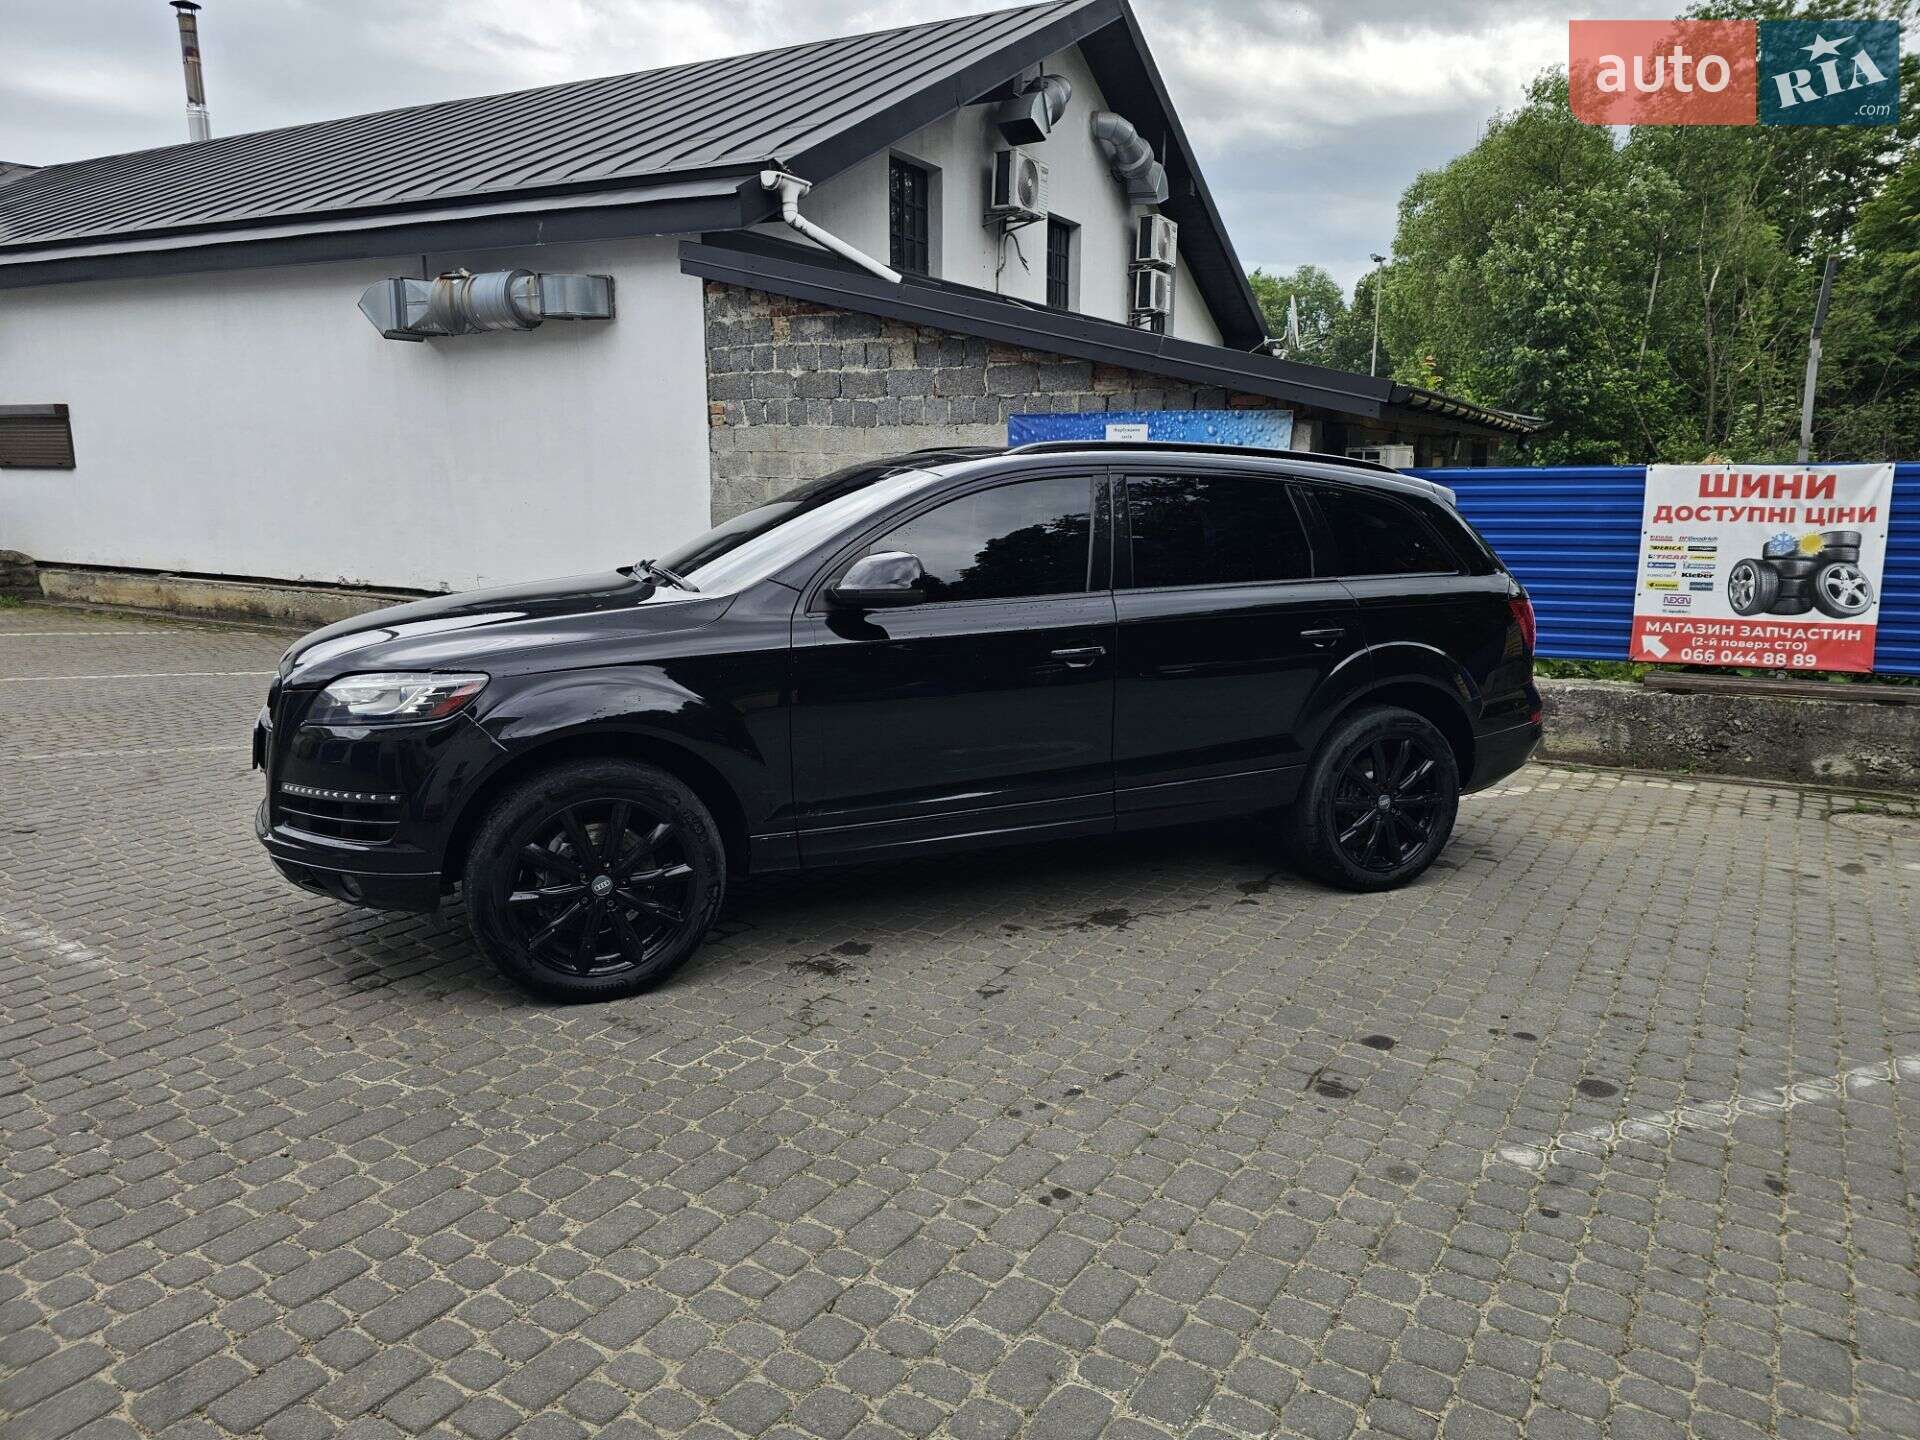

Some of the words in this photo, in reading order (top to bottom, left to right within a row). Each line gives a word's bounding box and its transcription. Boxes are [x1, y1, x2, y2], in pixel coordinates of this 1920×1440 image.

[1698, 473, 1837, 500] ШИНИ
[1653, 505, 1796, 524] ДОСТУПНІ
[1805, 506, 1877, 526] ЦІНИ
[1663, 596, 1692, 605] NEXEN
[1645, 621, 1734, 637] МАГАЗИН
[1739, 625, 1861, 641] ЗАПЧАСТИН
[1691, 637, 1717, 648] (2-й
[1721, 639, 1771, 650] поверх
[1774, 640, 1808, 651] СТО)
[1680, 648, 1715, 662] 066
[1720, 650, 1758, 664] 044
[1762, 652, 1787, 666] 88
[1792, 653, 1817, 667] 89
